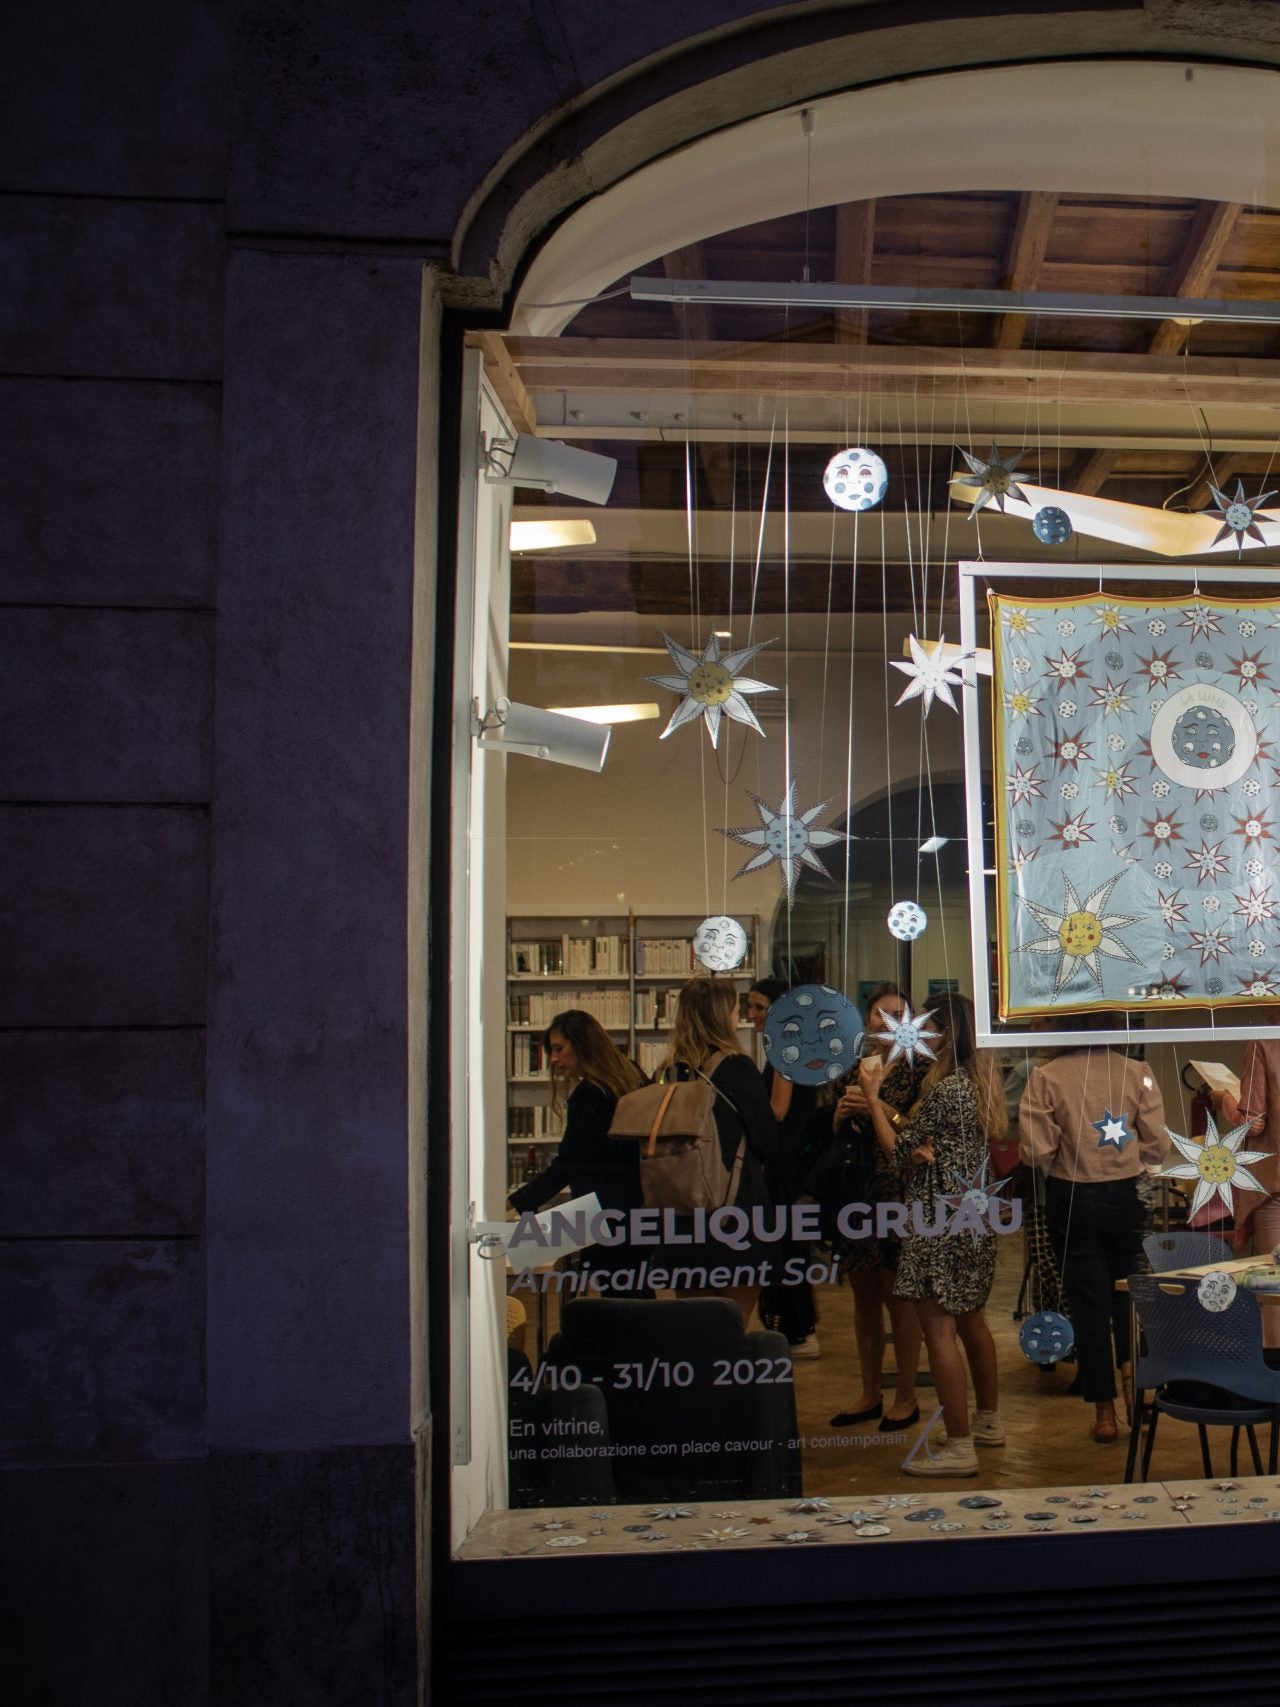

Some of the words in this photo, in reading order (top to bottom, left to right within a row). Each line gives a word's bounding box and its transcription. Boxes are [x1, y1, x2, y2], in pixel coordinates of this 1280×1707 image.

[508, 1203, 822, 1251] ANGELIQUE
[836, 1198, 1023, 1240] GRUAU
[509, 1259, 772, 1294] Amicalement
[782, 1253, 843, 1286] Soi
[509, 1363, 582, 1395] 4/10
[613, 1357, 695, 1392] 31/10
[712, 1357, 794, 1386] 2022
[509, 1419, 536, 1437] En
[541, 1417, 604, 1437] vitrine,
[509, 1448, 537, 1460] una
[540, 1442, 647, 1460] collaborazione
[650, 1443, 678, 1455] con
[681, 1440, 721, 1457] place
[724, 1438, 774, 1453] cavour
[787, 1435, 806, 1450] art
[810, 1431, 907, 1451] contemporain
